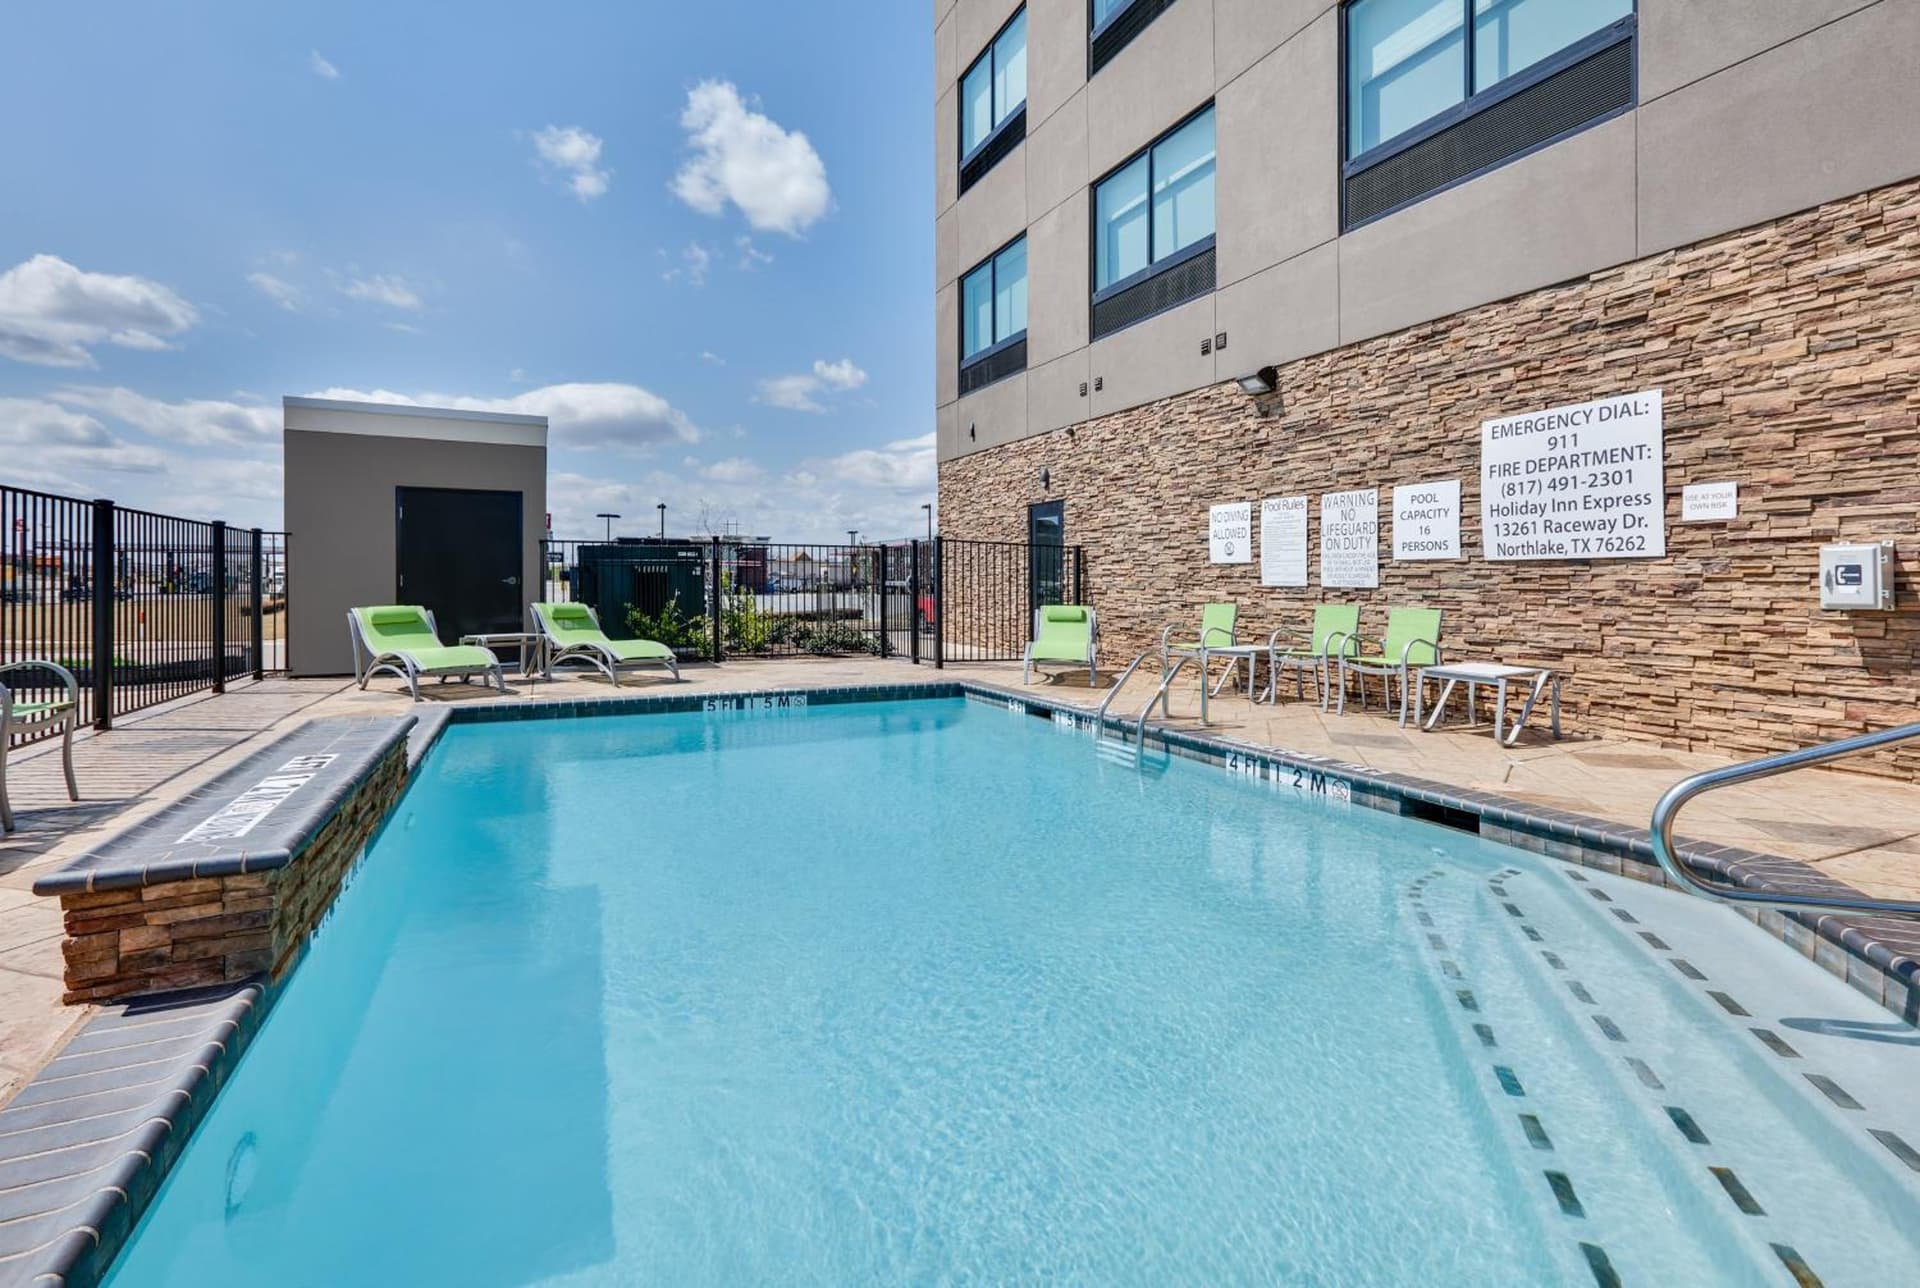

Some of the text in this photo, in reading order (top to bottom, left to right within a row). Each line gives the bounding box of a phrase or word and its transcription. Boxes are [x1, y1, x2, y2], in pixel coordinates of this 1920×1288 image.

[1491, 400, 1649, 440] EMERGENCY DIAL:
[1547, 433, 1578, 451] 911
[1489, 444, 1652, 479] FIRE DEPARTMENT:
[1501, 469, 1633, 499] (817) 491-2301
[1264, 499, 1305, 512] Pool Rules
[1324, 492, 1375, 509] WARNING
[1410, 493, 1439, 504] POOL
[1490, 492, 1652, 518] Holiday Inn Express
[1212, 509, 1249, 523] NO DIVING
[1340, 508, 1356, 521] NO
[1400, 508, 1450, 521] CAPACITY
[1213, 526, 1248, 540] ALLOWED
[1321, 521, 1376, 537] LIFEGUARD
[1419, 525, 1431, 536] 16
[1494, 513, 1649, 537] 13261 Raceway Dr.
[1325, 536, 1372, 551] ON DUTY
[1401, 540, 1449, 552] PERSONS
[1497, 535, 1646, 557] Northlake, TX 76262
[707, 700, 716, 712] 5
[778, 695, 790, 708] M
[1229, 754, 1238, 771] 4
[1245, 757, 1258, 777] FT
[1311, 773, 1327, 794] M
